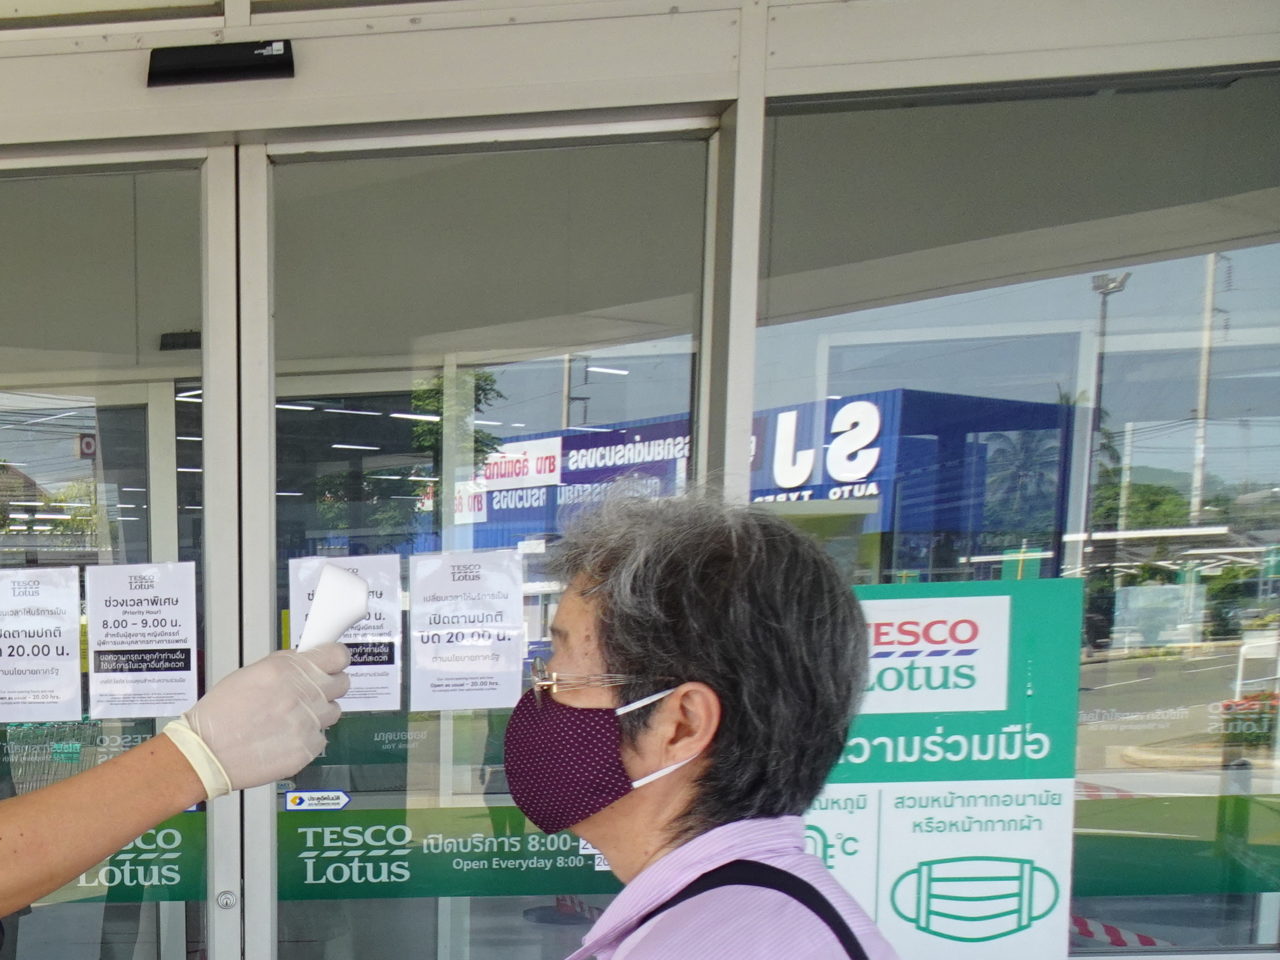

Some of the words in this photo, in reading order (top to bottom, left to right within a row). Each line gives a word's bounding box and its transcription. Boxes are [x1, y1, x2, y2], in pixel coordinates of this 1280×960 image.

[452, 573, 480, 582] Lotus
[12, 587, 40, 597] Lotus
[104, 596, 179, 608] ช่วงเวลาพิเศษ
[102, 619, 128, 629] 8.00
[141, 618, 167, 628] 9.00
[170, 619, 182, 628] น.
[429, 611, 503, 625] เปิดตามปกติ
[418, 630, 440, 644] ปิด
[446, 631, 491, 643] 20.00
[496, 631, 511, 642] น.
[8, 644, 50, 657] 20.00
[56, 645, 70, 656] น.
[840, 725, 1051, 765] วามร่วมมือ
[894, 789, 1062, 809] สวมหน้ากากอนามัย
[912, 815, 1043, 833] หรือหน้ากากผ้า
[297, 825, 412, 848] TESCO
[422, 834, 521, 854] เปิดบริการ
[304, 857, 411, 884] Lotus
[452, 858, 488, 872] Open
[491, 857, 553, 872] Everyday
[556, 856, 584, 868] 8:00
[76, 858, 182, 887] Lotus
